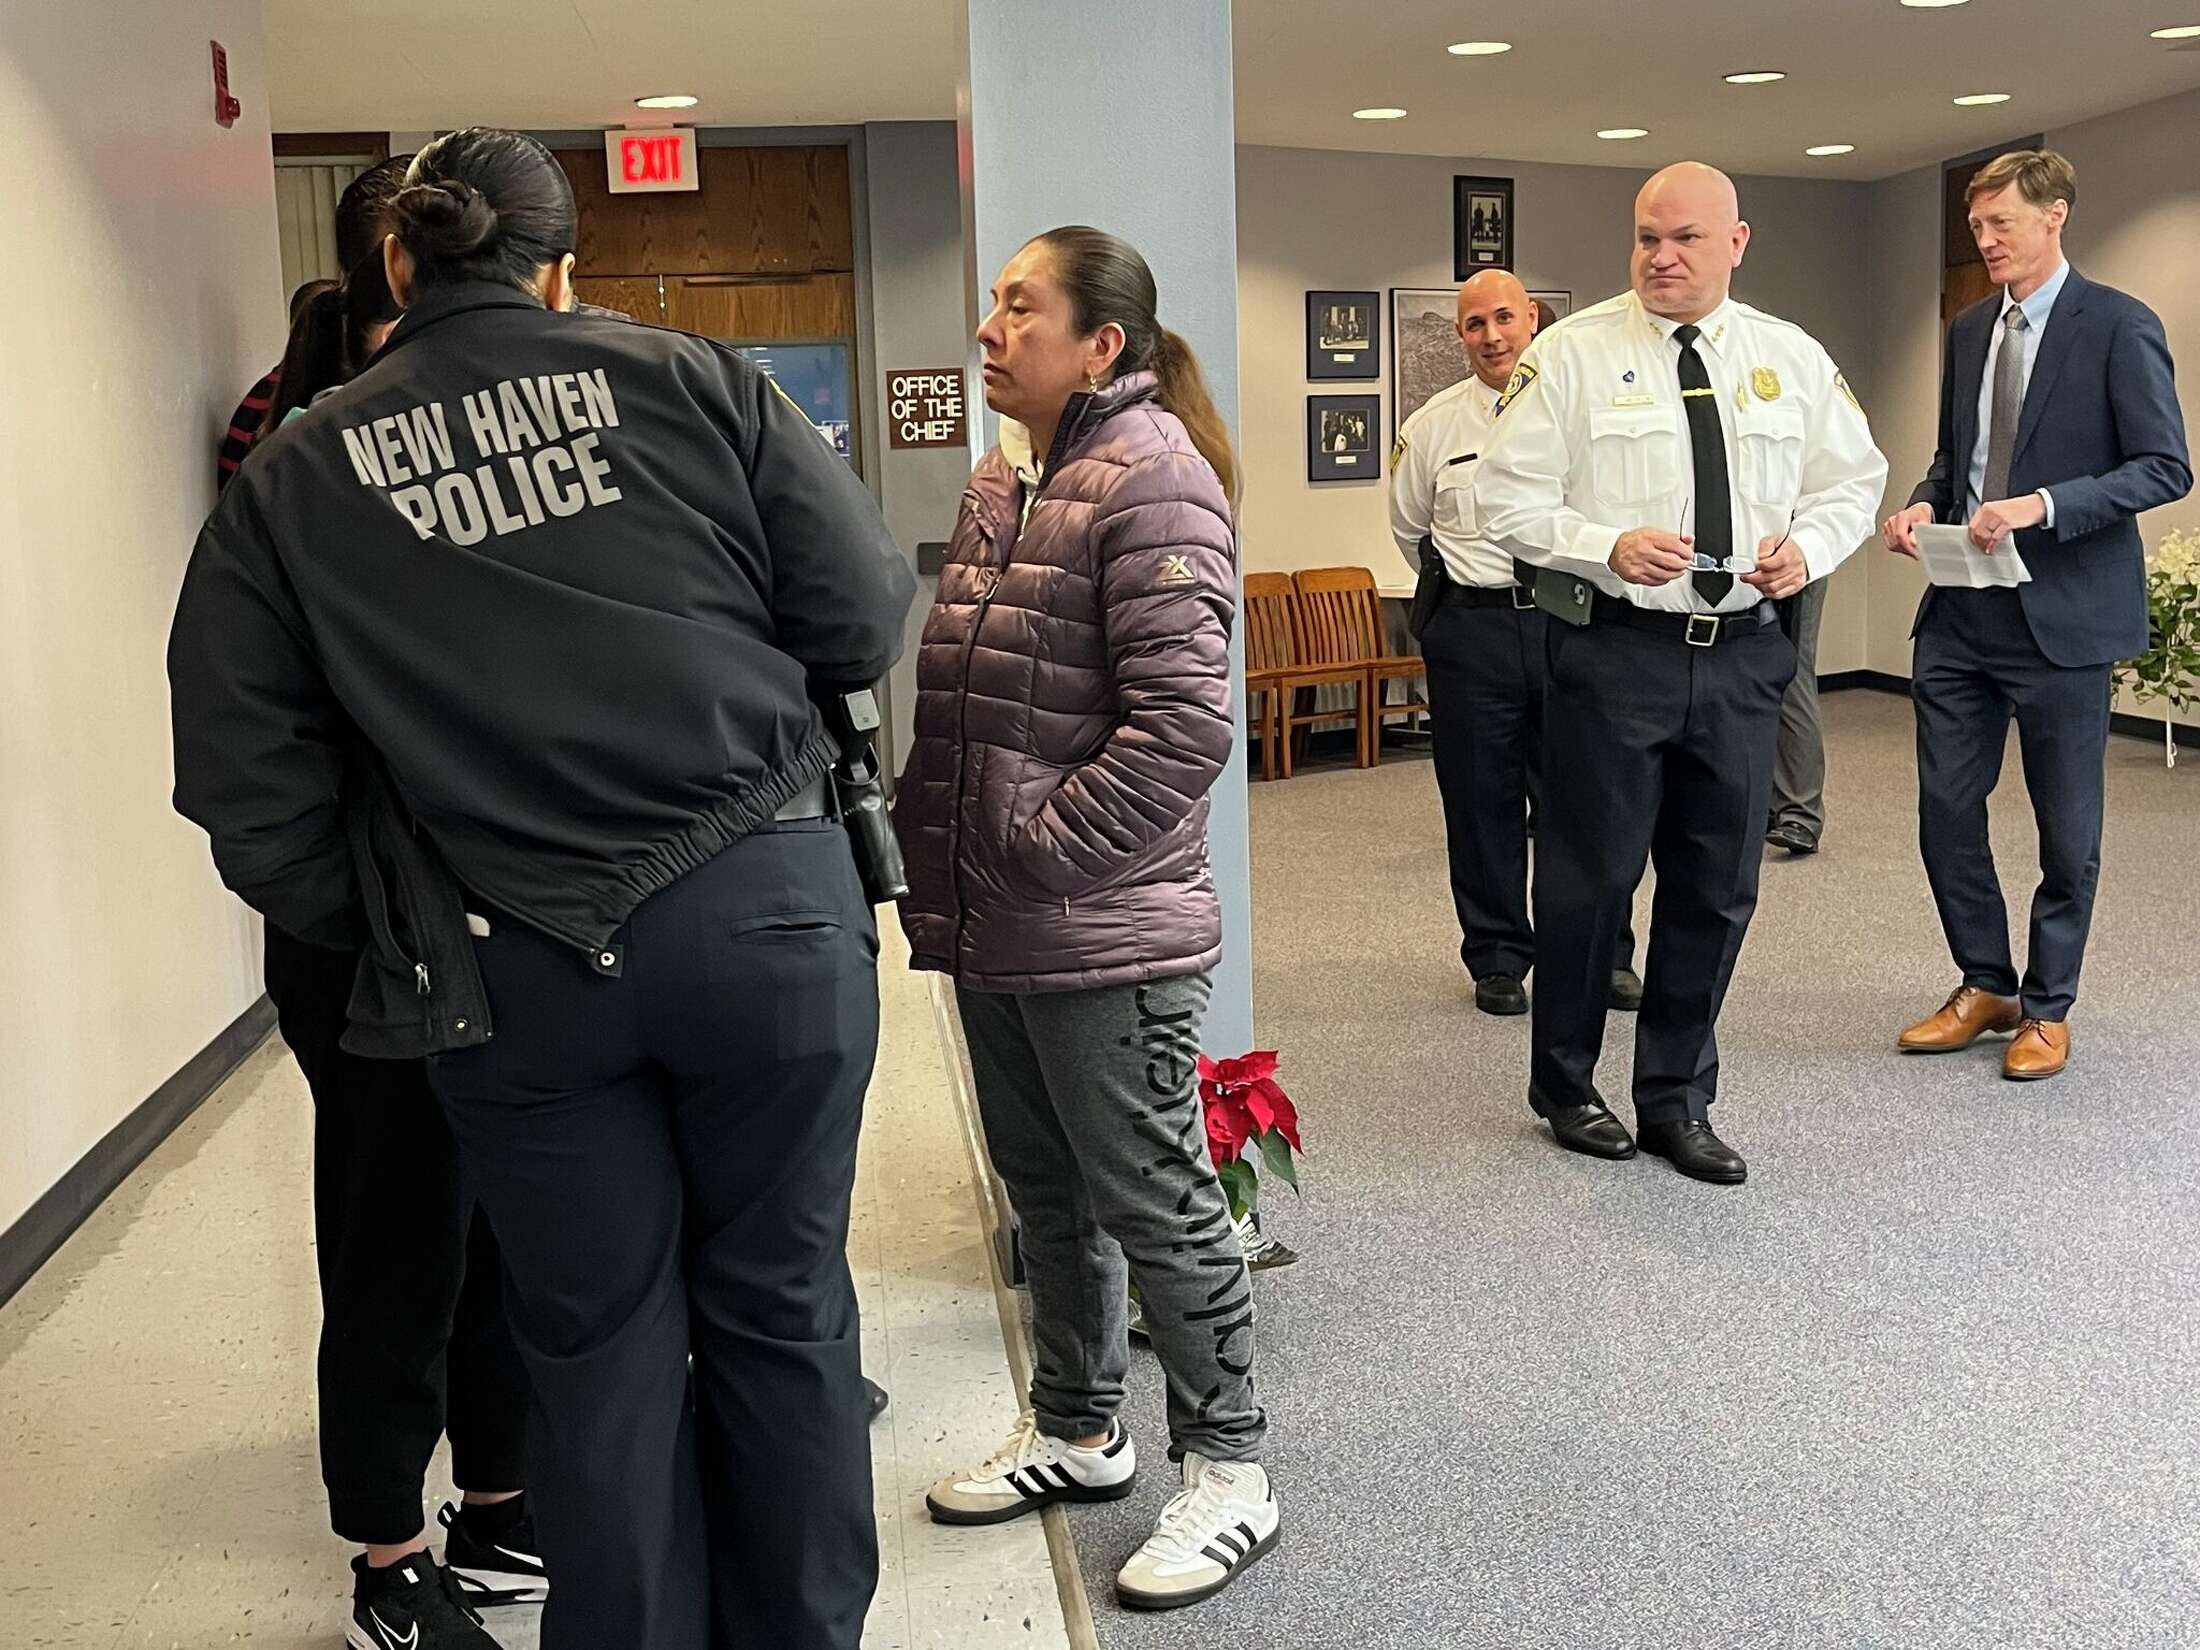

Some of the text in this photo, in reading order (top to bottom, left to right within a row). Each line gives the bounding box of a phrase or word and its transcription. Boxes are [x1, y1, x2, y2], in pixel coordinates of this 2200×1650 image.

[621, 136, 683, 183] EXIT
[892, 375, 960, 397] OFFICE
[891, 397, 963, 420] OF THE
[341, 368, 620, 487] NEW HAVEN
[900, 420, 956, 442] CHIEF
[389, 432, 623, 547] POLICE
